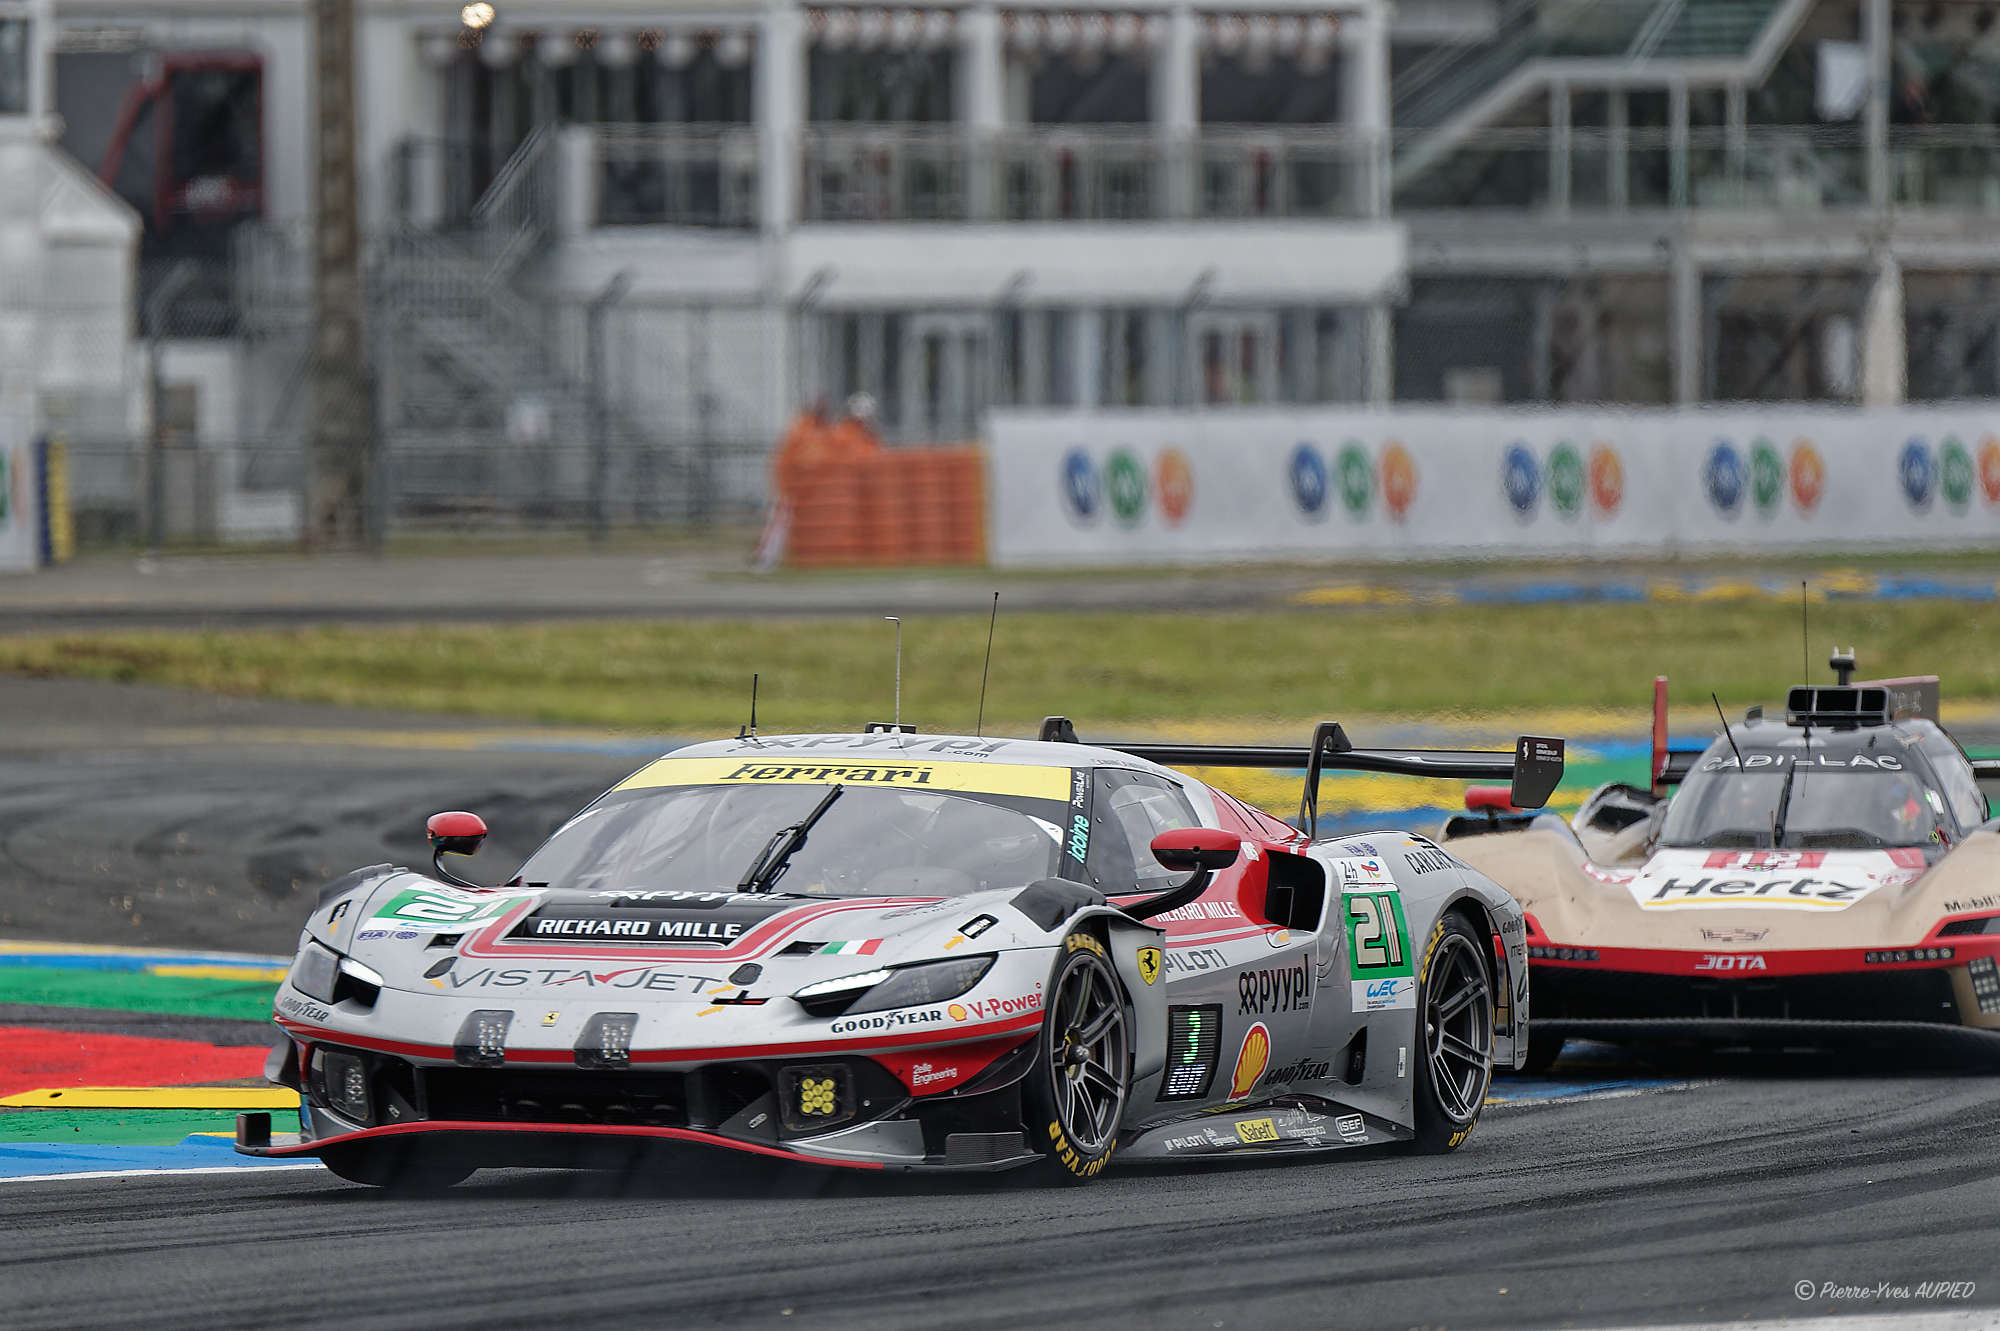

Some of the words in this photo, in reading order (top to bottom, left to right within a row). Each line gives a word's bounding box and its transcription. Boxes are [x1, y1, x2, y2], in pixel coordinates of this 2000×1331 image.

[1703, 754, 1902, 772] CADILLAC
[720, 763, 933, 784] Ferrari
[1653, 877, 1867, 900] Hertz
[1203, 901, 1241, 919] MILLE
[537, 919, 650, 935] RICHARD
[658, 921, 742, 939] MILLE
[1350, 894, 1404, 969] 21
[1695, 955, 1768, 971] JOTA
[1259, 953, 1309, 1014] pyypl
[1367, 980, 1398, 998] WEC
[967, 991, 1042, 1019] V-Power
[913, 1068, 958, 1086] Engineering
[1172, 1134, 1208, 1149] PILOTI
